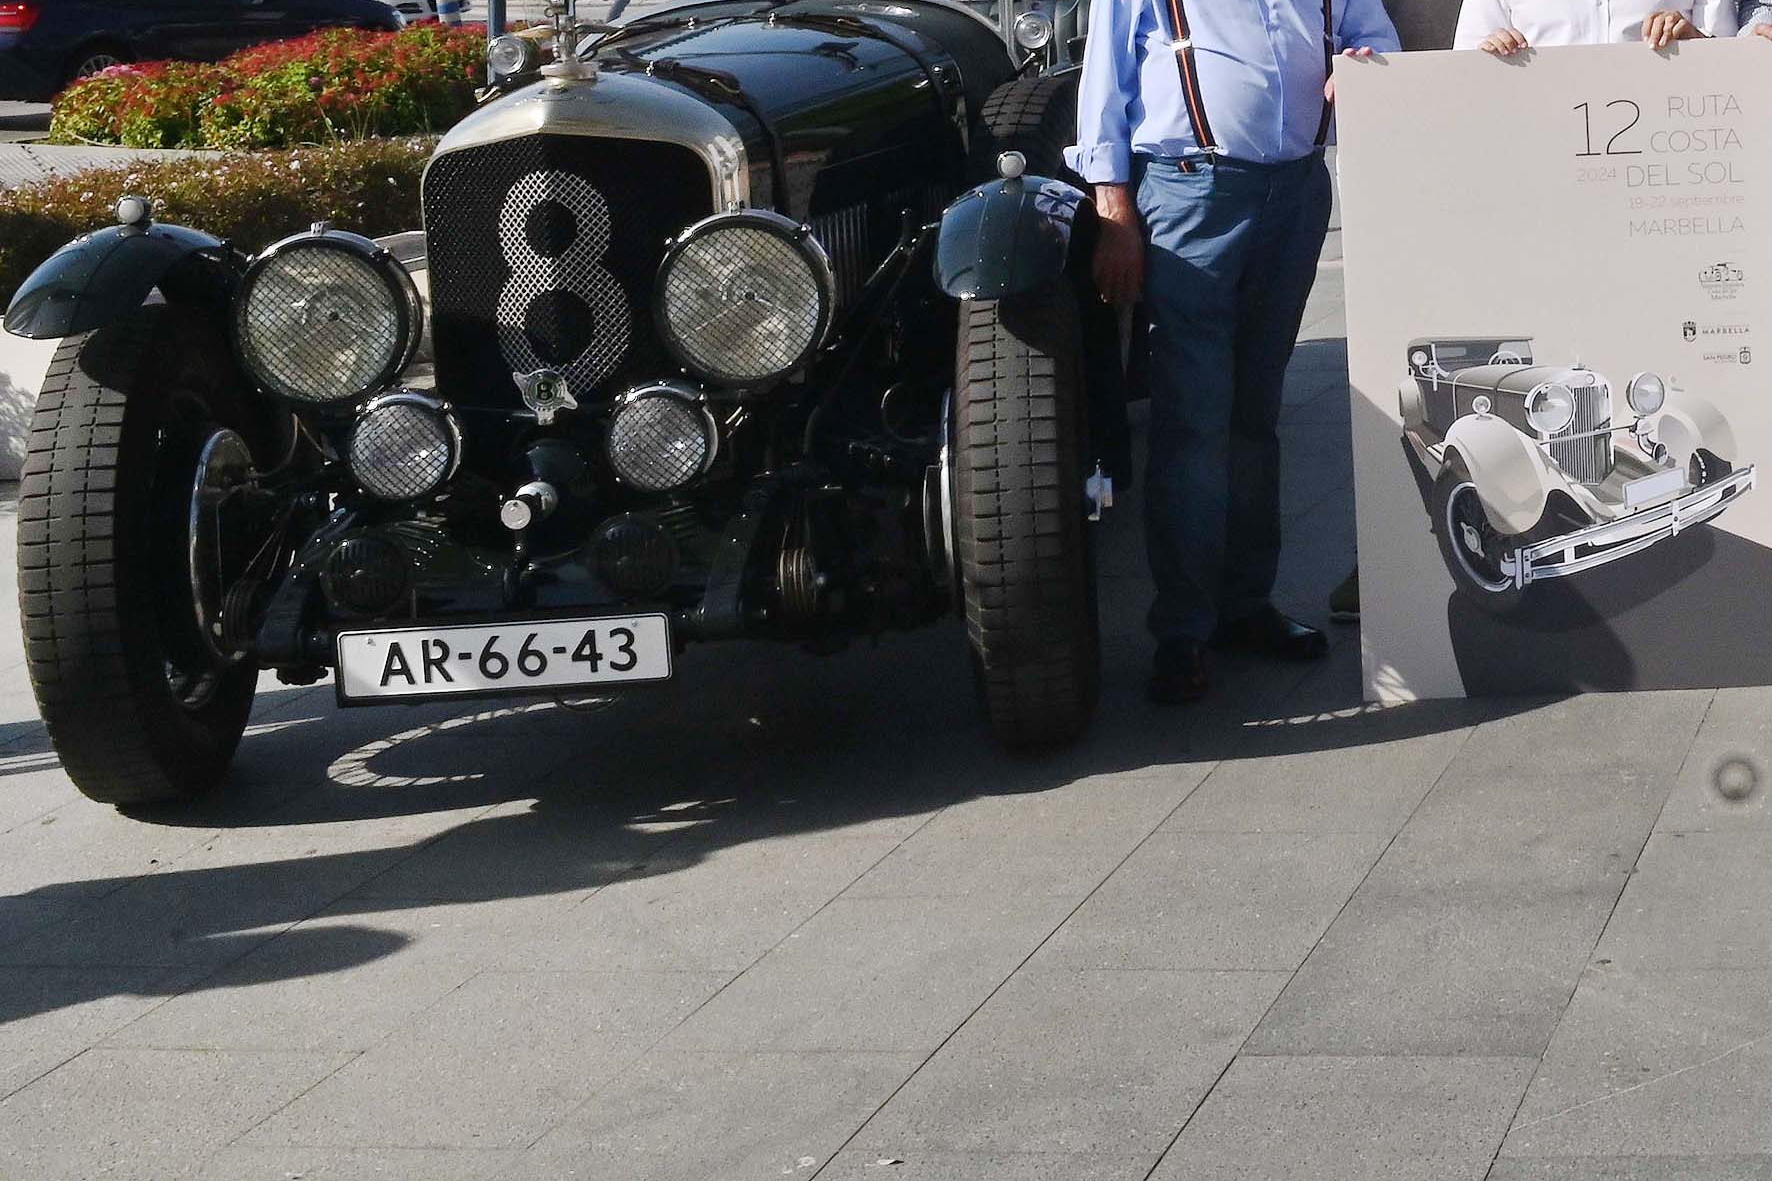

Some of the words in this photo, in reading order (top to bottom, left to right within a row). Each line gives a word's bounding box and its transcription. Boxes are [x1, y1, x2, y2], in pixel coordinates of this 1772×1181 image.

[1572, 99, 1643, 157] 12
[1667, 94, 1743, 119] RUTA
[1650, 128, 1744, 154] COSTA
[1576, 166, 1616, 183] 2024
[1626, 164, 1681, 188] DEL
[1687, 161, 1745, 185] SOL
[1629, 216, 1746, 237] MARBELLA
[496, 170, 633, 398] 8
[379, 627, 638, 687] AR-66-43
